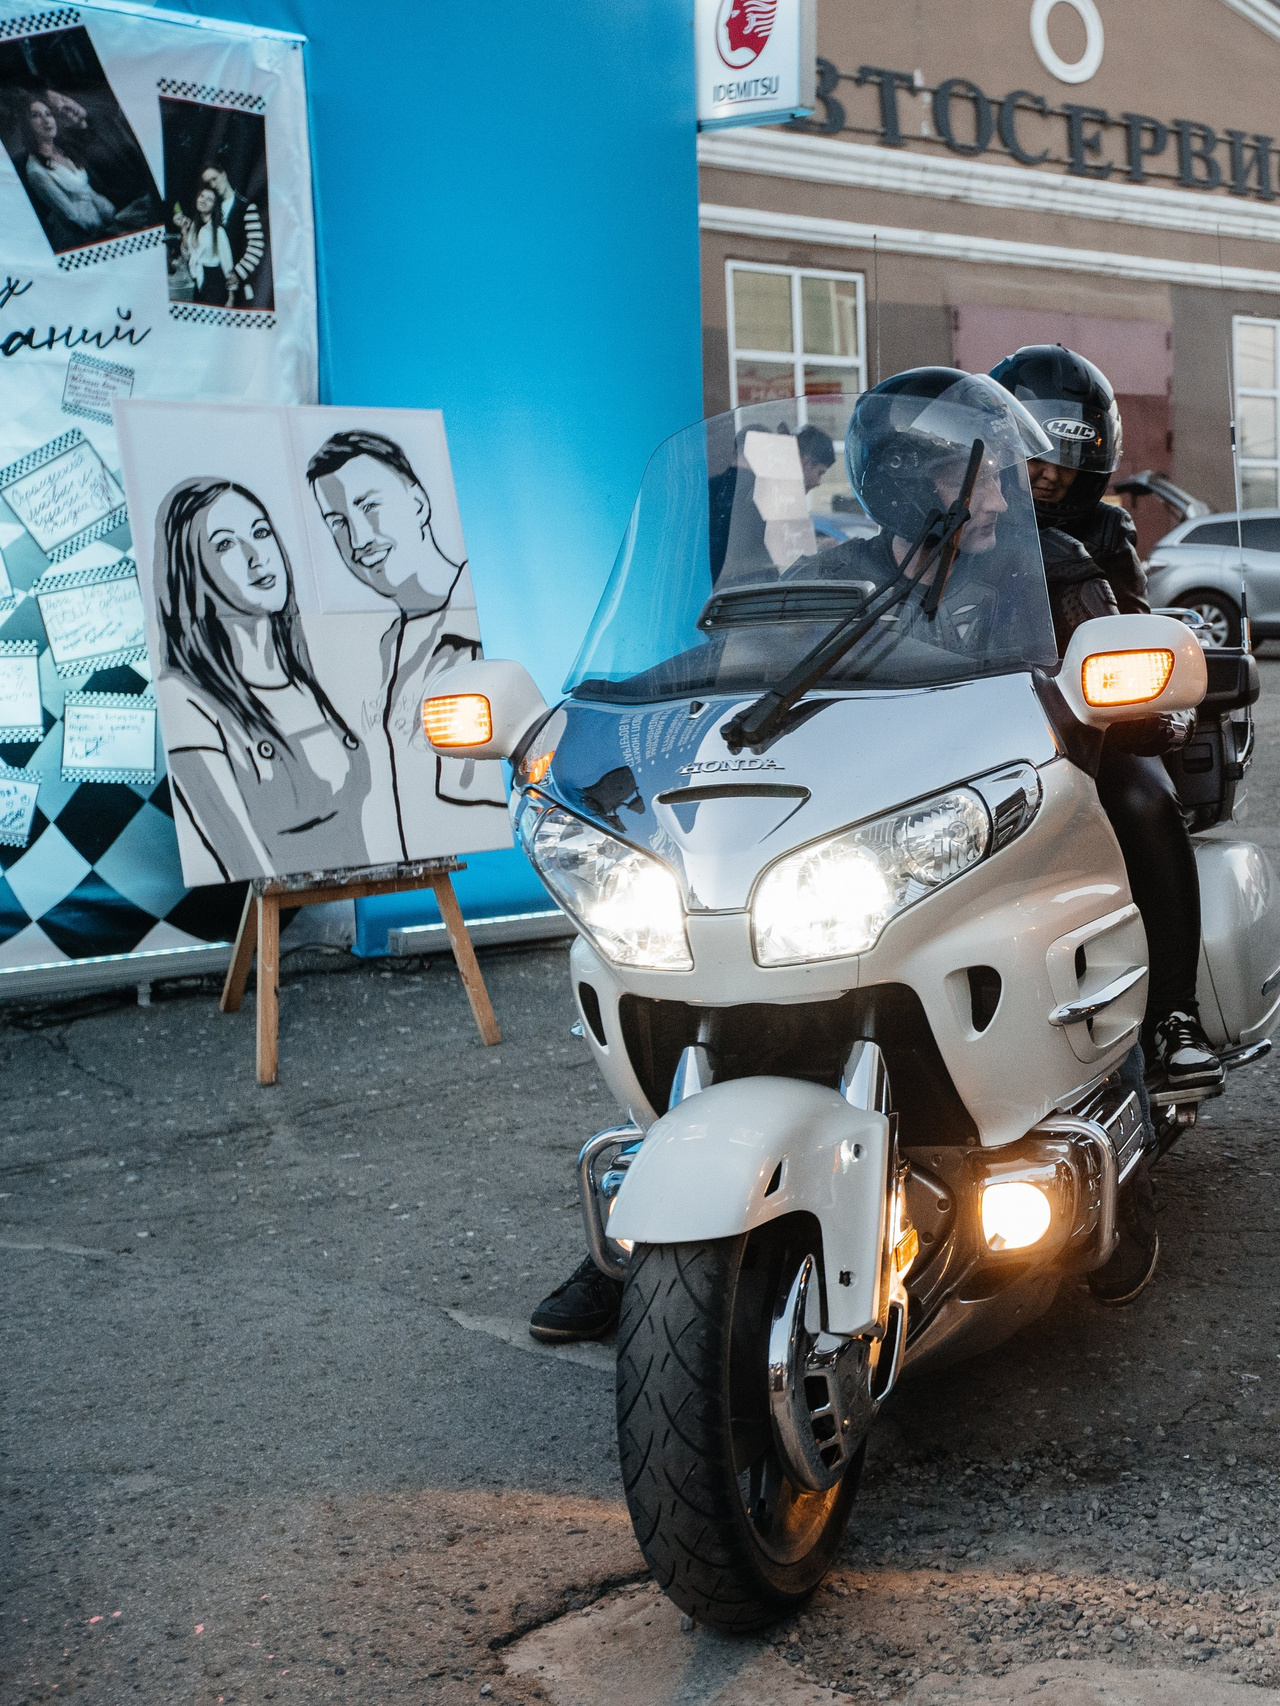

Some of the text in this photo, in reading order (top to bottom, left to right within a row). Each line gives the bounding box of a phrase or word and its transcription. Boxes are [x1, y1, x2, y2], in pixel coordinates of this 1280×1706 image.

[712, 75, 780, 103] IDEMITSU
[1050, 421, 1094, 438] HJC
[679, 758, 786, 776] HONDA
